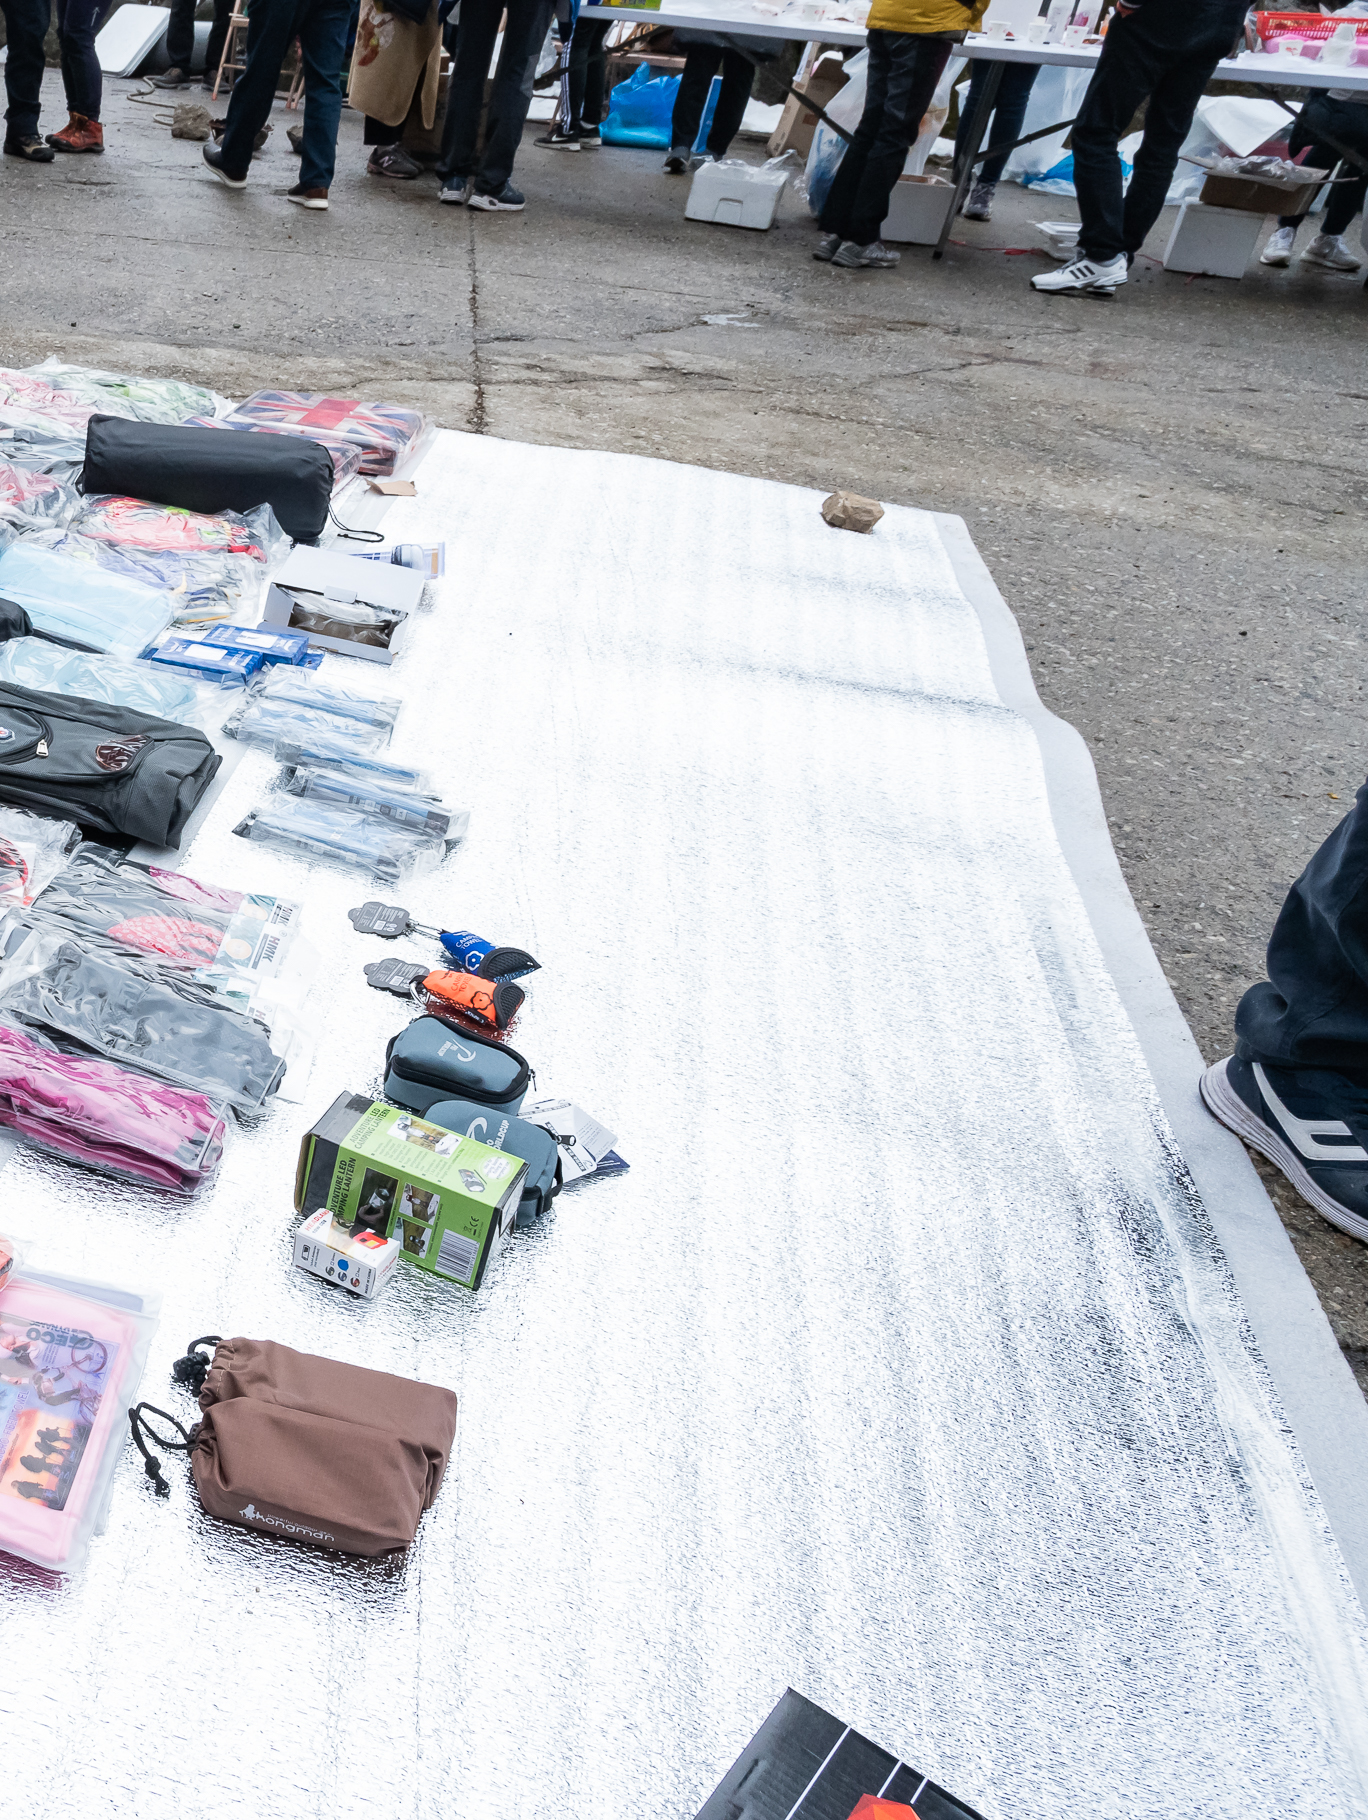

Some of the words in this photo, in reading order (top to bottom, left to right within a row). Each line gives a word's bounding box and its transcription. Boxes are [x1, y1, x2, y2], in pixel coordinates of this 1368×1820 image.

[262, 935, 281, 963] HMK
[350, 1115, 373, 1143] ADVENTURE
[355, 1128, 375, 1150] CAMPING
[372, 1108, 391, 1130] LANTERN
[344, 1157, 356, 1188] LANTERN
[330, 1174, 345, 1213] DVENTURE
